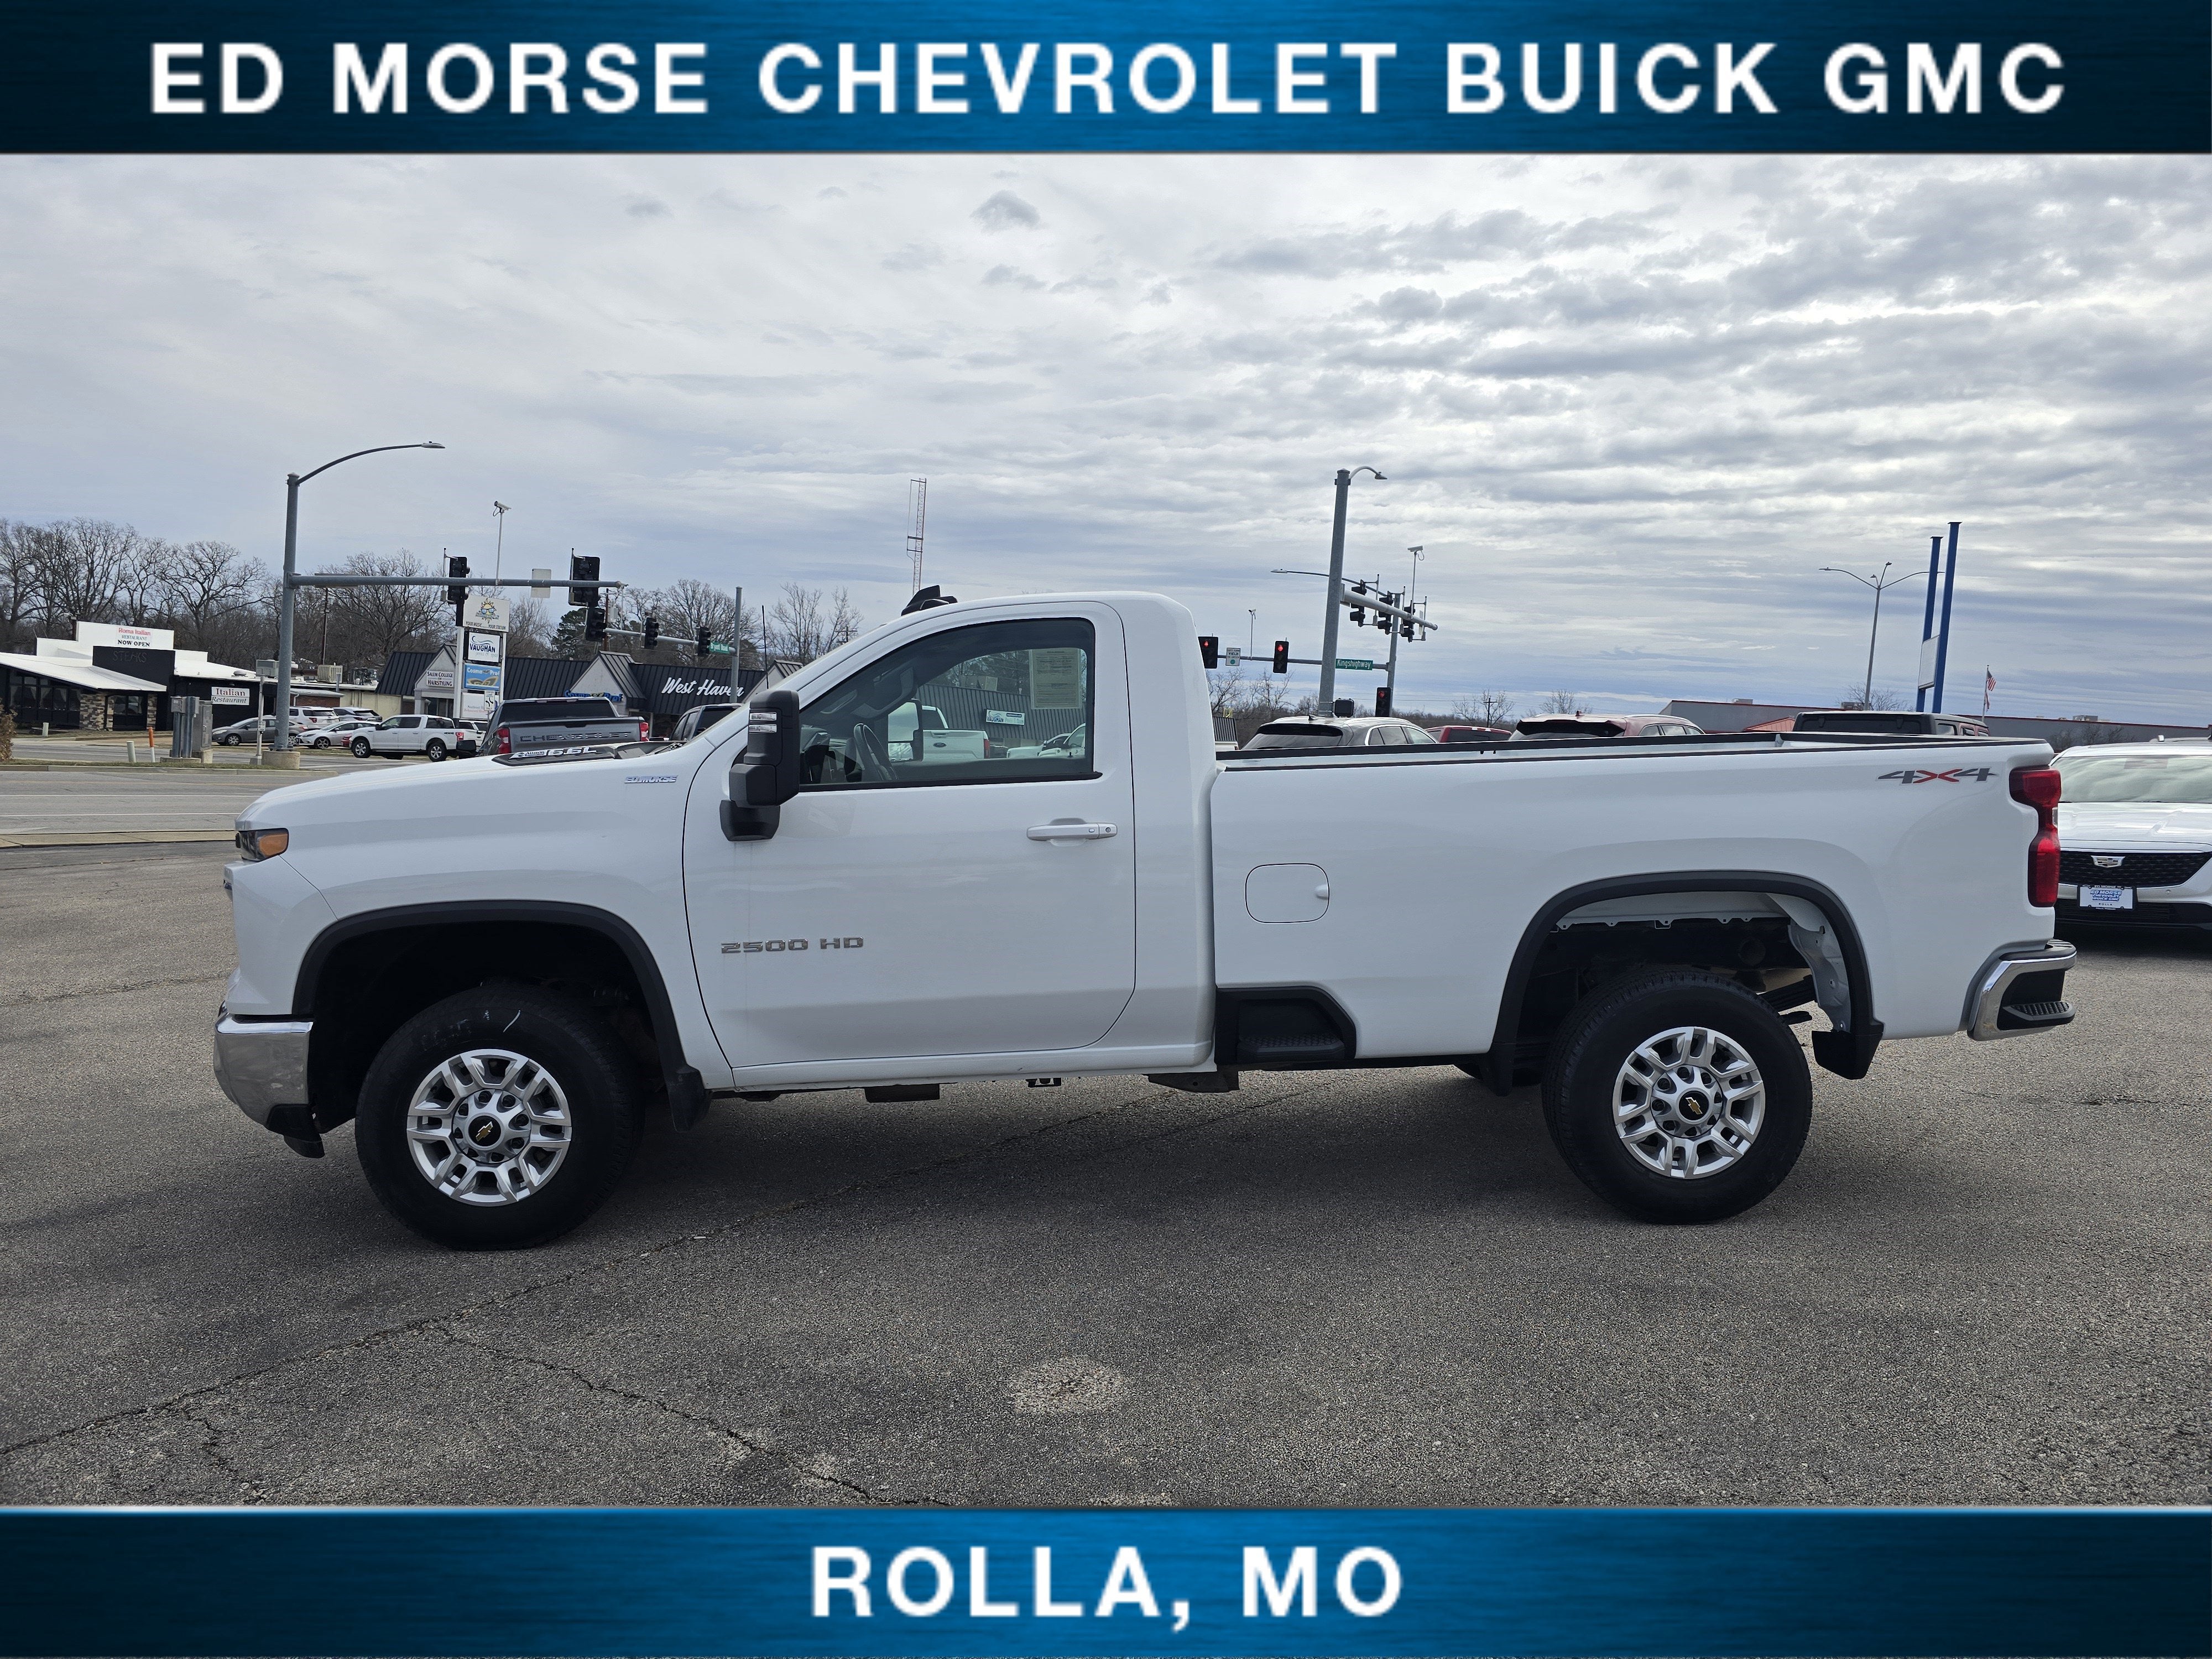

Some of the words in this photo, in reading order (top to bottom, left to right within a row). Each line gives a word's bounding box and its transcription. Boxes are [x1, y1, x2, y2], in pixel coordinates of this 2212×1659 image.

[469, 643, 495, 653] VAUGHAN
[1337, 659, 1371, 669] Kingshighway
[661, 677, 697, 694] West
[216, 688, 246, 696] Italian
[519, 732, 632, 742] CHEVROLET
[547, 747, 597, 756] 6.6L
[721, 938, 808, 954] 2500
[820, 936, 864, 950] HD
